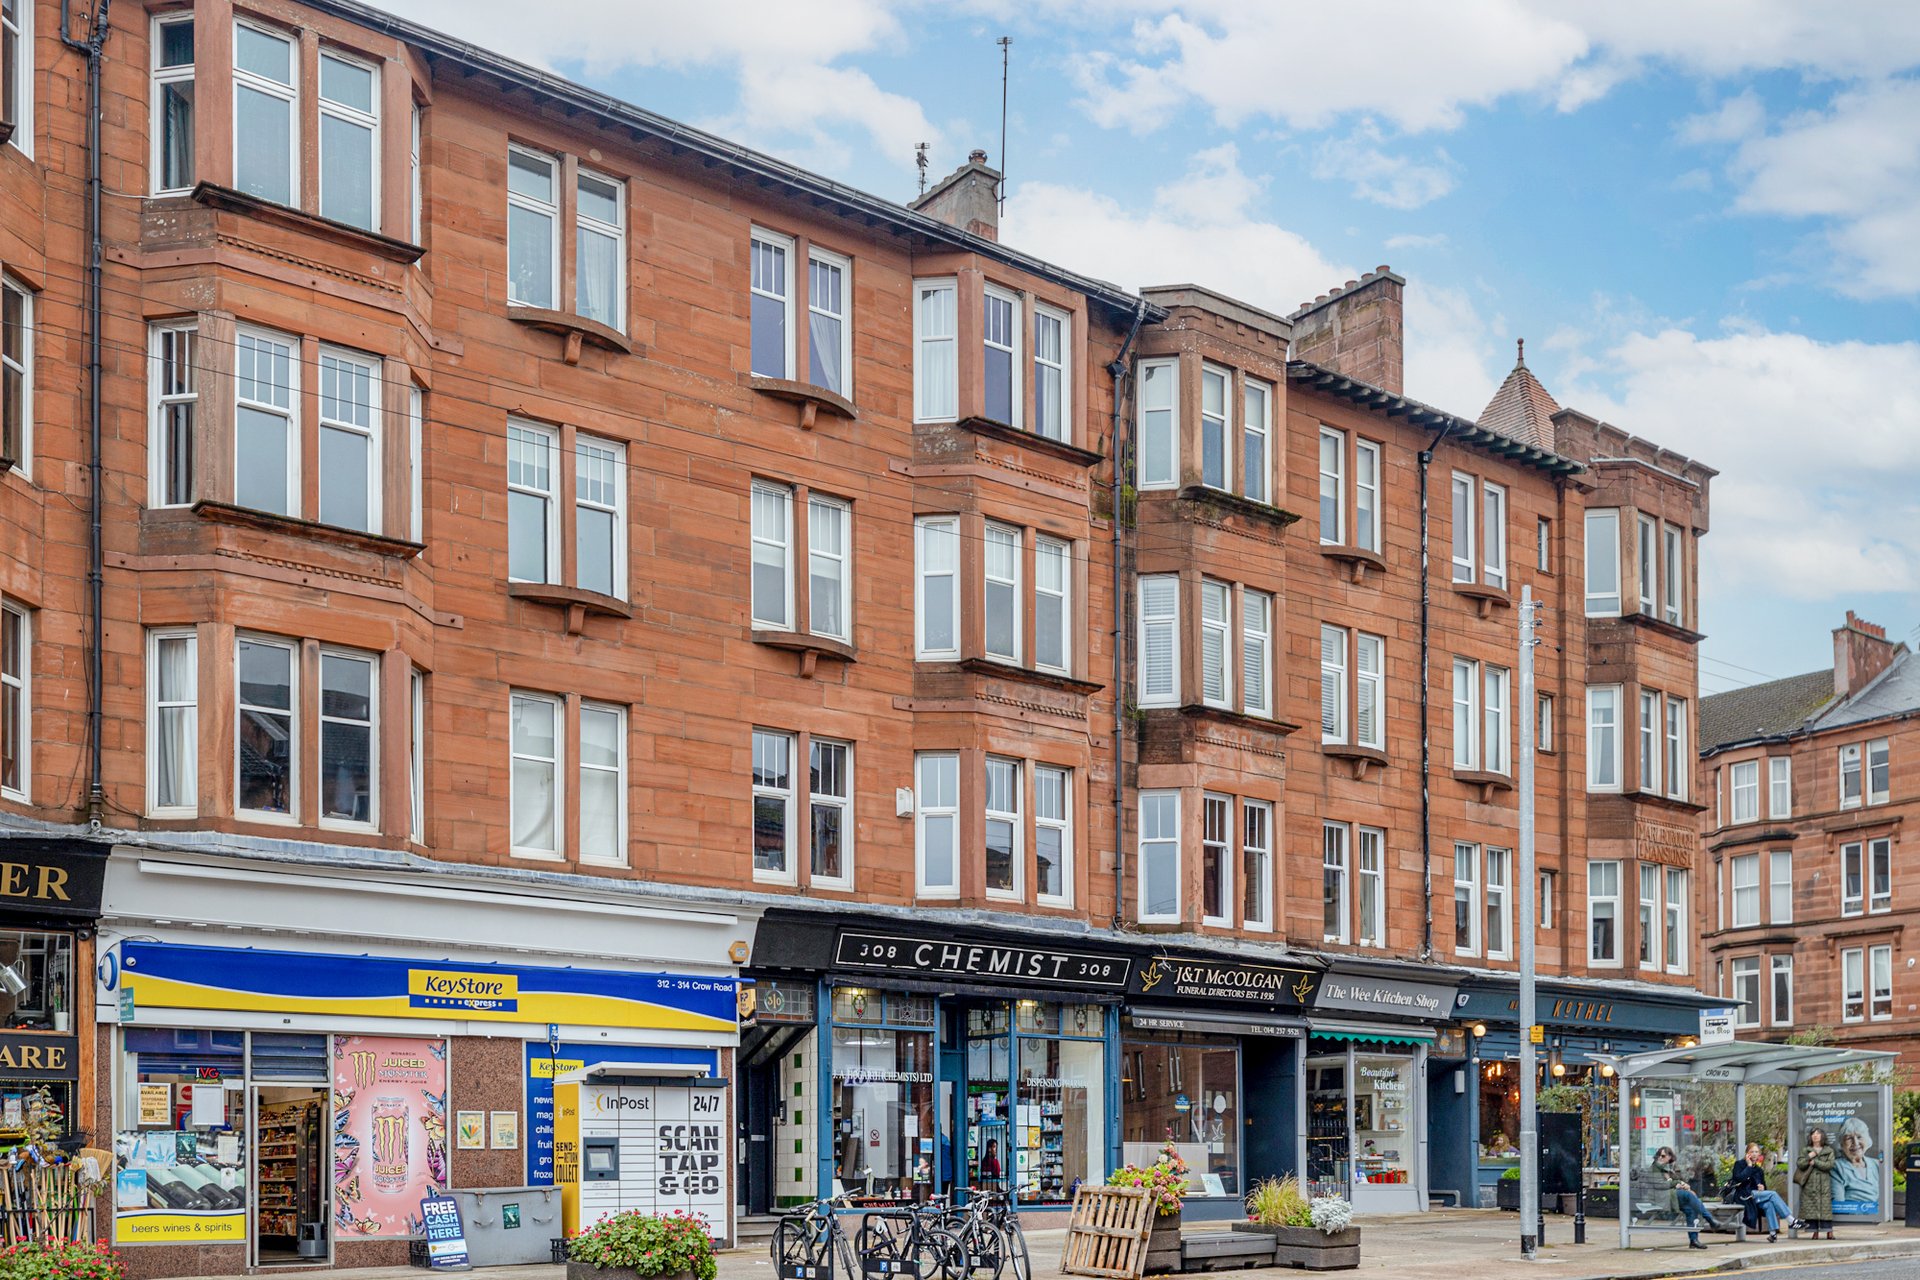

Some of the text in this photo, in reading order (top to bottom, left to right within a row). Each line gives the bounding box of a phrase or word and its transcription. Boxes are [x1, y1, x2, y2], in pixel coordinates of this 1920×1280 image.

[1643, 842, 1687, 865] MANSIONS
[0, 862, 71, 901] ER
[860, 943, 1111, 978] 308 CHEMIST 308
[1174, 966, 1284, 989] J&T McCOLGAN
[426, 976, 502, 995] KeyStore
[657, 980, 670, 988] 312
[677, 981, 690, 989] 314
[692, 982, 711, 990] Crow
[713, 983, 733, 992] Road
[1176, 986, 1275, 1000] FUNERAL DIRECTORS EST. 1936
[1326, 984, 1439, 1012] The Wee Kitchen Shop
[464, 999, 497, 1009] express
[767, 994, 781, 1009] 310
[1159, 1020, 1184, 1028] SERVICE
[0, 1045, 67, 1069] ARE
[382, 1058, 426, 1068] JUICED
[196, 1068, 219, 1079] IVG
[539, 1062, 578, 1073] KeyStore
[1360, 1066, 1395, 1079] Beautiful
[1706, 1069, 1721, 1077] CROW
[378, 1070, 428, 1079] MONSTER
[920, 1072, 933, 1082] LTD
[1026, 1077, 1061, 1088] DISPENSING
[1374, 1079, 1405, 1090] Kitchens
[607, 1096, 649, 1110] InPost
[694, 1095, 719, 1112] 24/7
[1837, 1100, 1862, 1108] meter's
[537, 1112, 554, 1121] mag
[1825, 1109, 1845, 1117] things
[659, 1125, 718, 1151] SCAN
[537, 1140, 553, 1149] fruit
[556, 1142, 573, 1151] SEND
[659, 1152, 718, 1174] TAP
[556, 1165, 578, 1183] COLLECT
[683, 1176, 718, 1195] GO
[422, 1201, 456, 1216] FREE
[426, 1213, 458, 1225] CASH
[132, 1222, 232, 1233] beers wines & spirits
[429, 1227, 461, 1239] HERE
